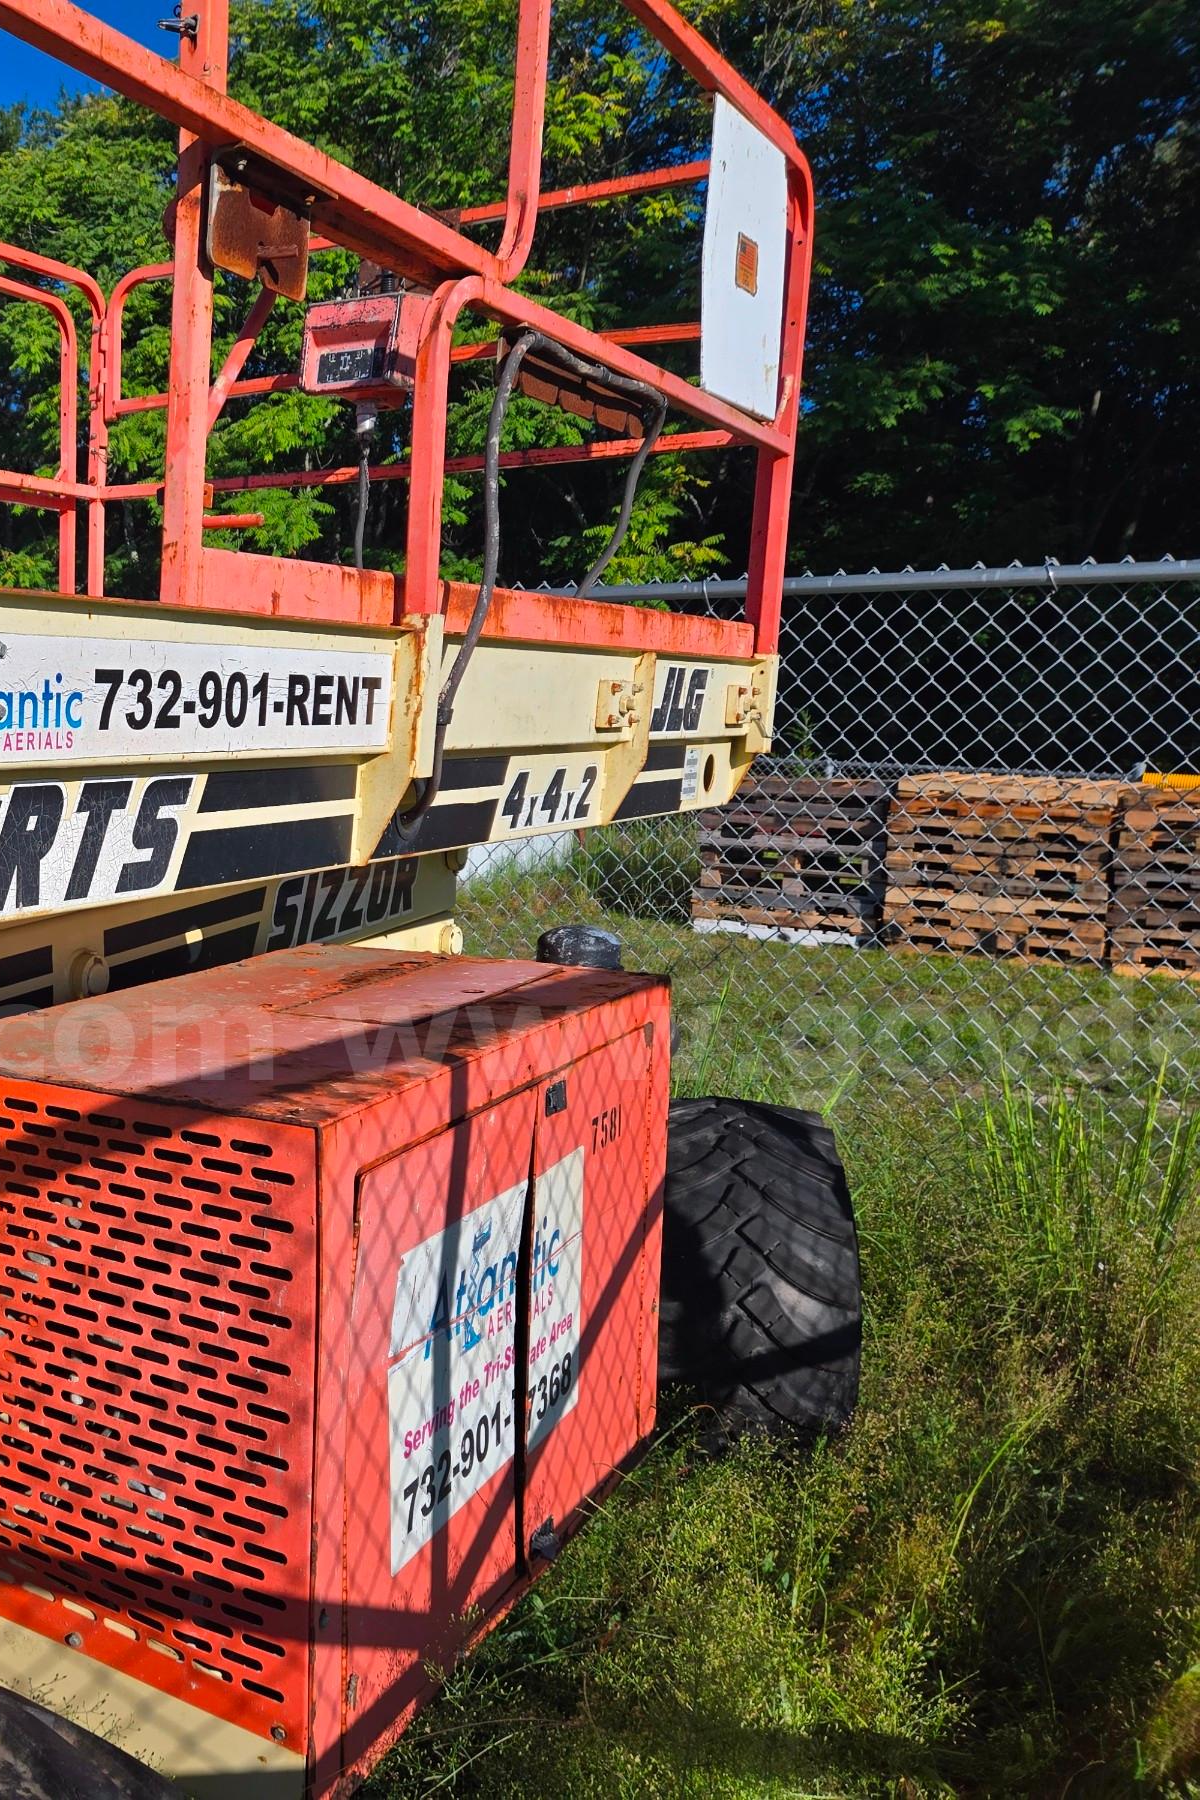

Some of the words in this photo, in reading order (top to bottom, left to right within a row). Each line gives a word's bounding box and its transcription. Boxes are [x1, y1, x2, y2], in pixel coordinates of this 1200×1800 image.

[94, 667, 383, 731] 732-901-RENT
[649, 666, 709, 732] JLG
[3, 730, 75, 752] AERIALS
[266, 857, 420, 951] SIZZOR
[592, 1103, 622, 1155] 7581
[488, 1283, 554, 1340] AERALS
[403, 1396, 456, 1459] Serving
[459, 1378, 480, 1410] the
[549, 1312, 573, 1347] Area
